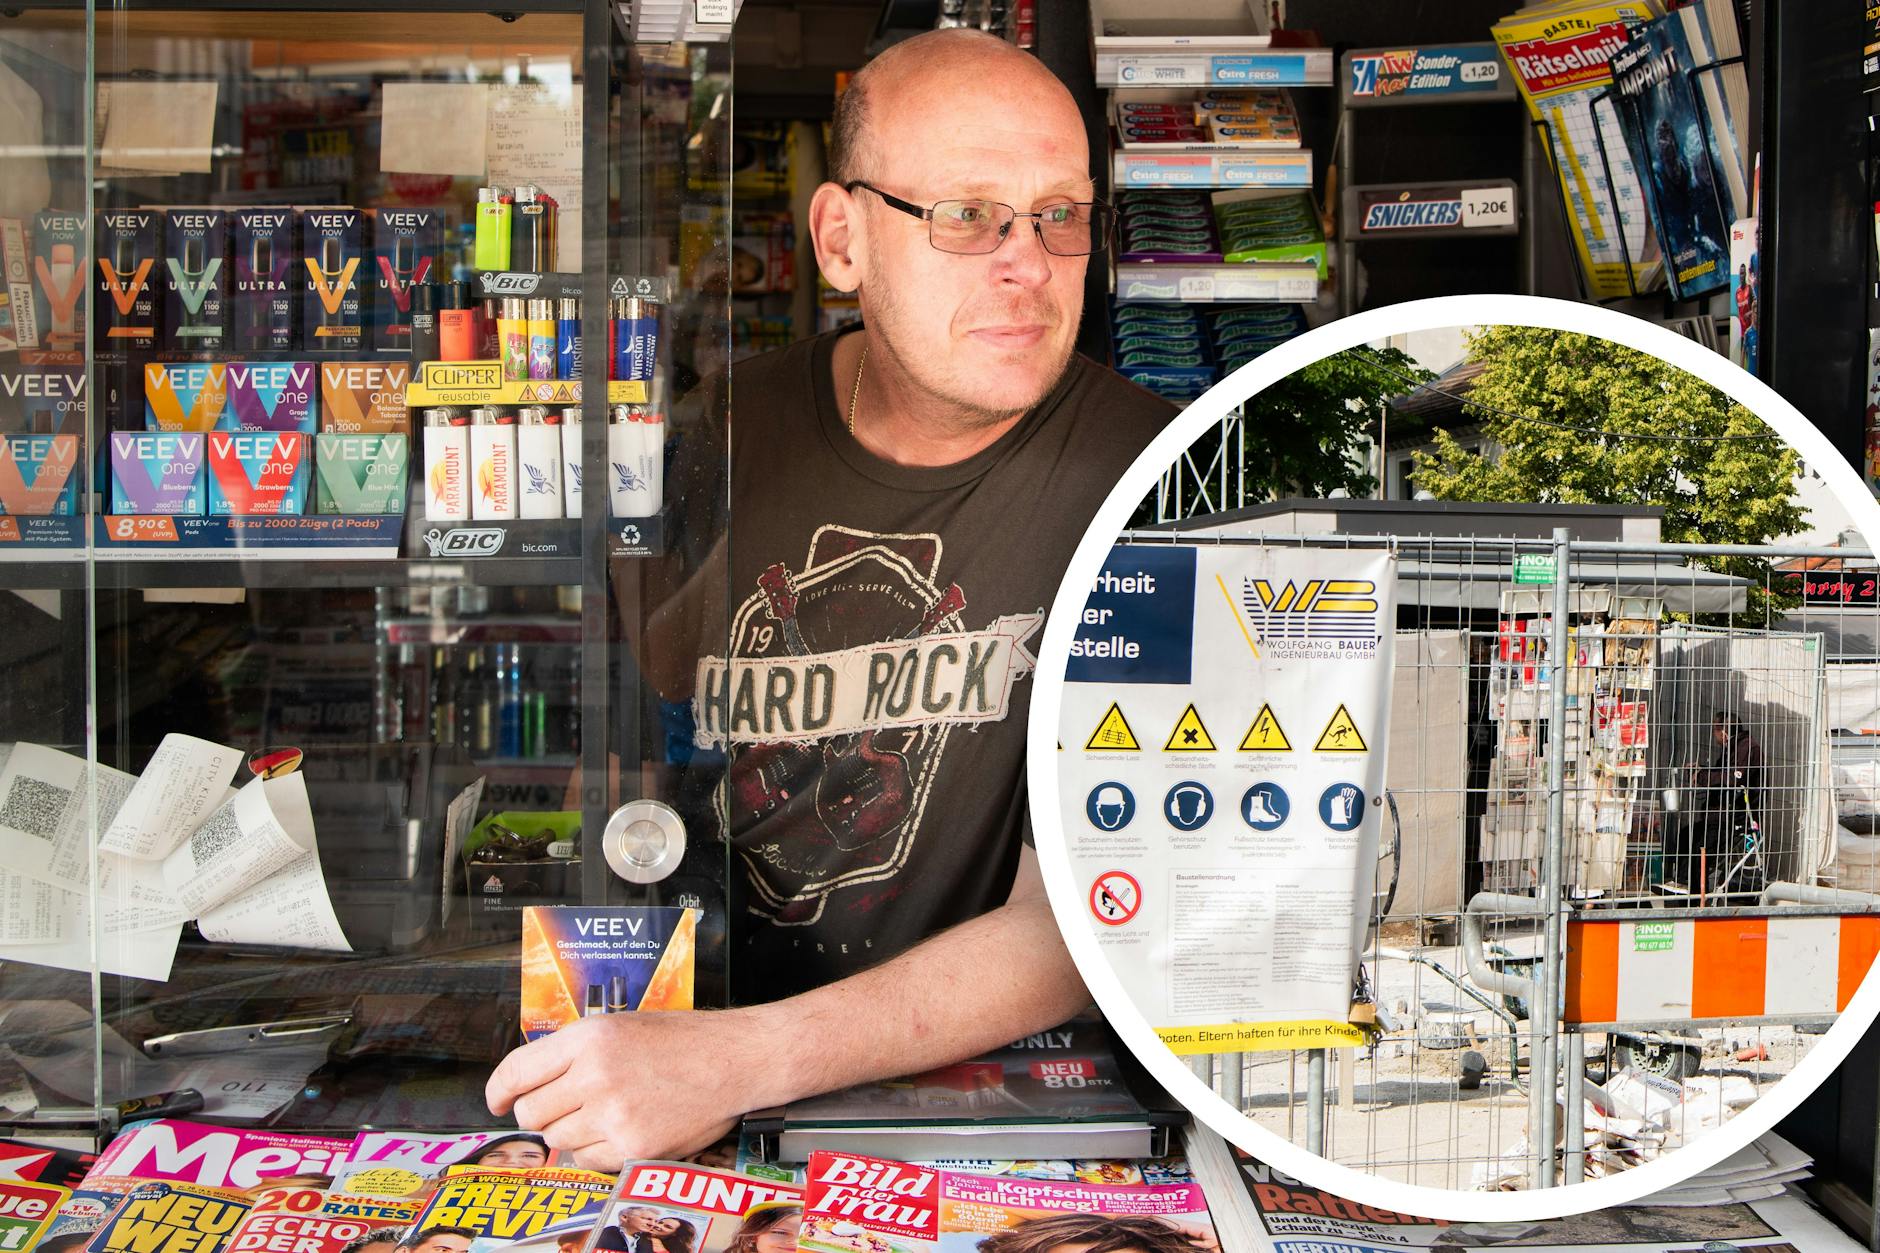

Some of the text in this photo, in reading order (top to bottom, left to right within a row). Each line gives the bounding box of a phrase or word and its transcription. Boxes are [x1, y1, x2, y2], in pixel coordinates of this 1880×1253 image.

[1544, 19, 1591, 38] BASTEI
[1415, 55, 1462, 70] Sonder-
[1155, 71, 1185, 79] WHITE
[1249, 71, 1280, 80] FRESH
[1620, 46, 1677, 96] IMPRINT
[1410, 74, 1451, 89] Edition
[383, 213, 429, 226] VEEV
[1366, 201, 1507, 228] SNICKERS 1,20€
[40, 217, 88, 231] VEEV
[105, 215, 150, 228] VEEV
[172, 215, 218, 228] VEEV
[241, 215, 285, 228] VEEV
[311, 215, 355, 228] VEEV
[52, 231, 76, 240] now
[116, 229, 137, 237] now
[183, 229, 205, 237] now
[394, 227, 417, 235] now
[101, 282, 150, 291] ULTRA
[169, 281, 218, 291] ULTRA
[239, 281, 287, 290] ULTRA
[308, 281, 356, 290] ULTRA
[15, 304, 26, 343] tödlich
[631, 335, 644, 381] Winston
[148, 368, 226, 390] VEEV
[229, 368, 310, 389] VEEV
[325, 368, 405, 390] VEEV
[432, 369, 497, 384] CLIPPER
[1, 374, 86, 397] VEEV
[192, 391, 225, 404] one
[275, 390, 309, 404] one
[370, 391, 402, 404] one
[438, 391, 491, 402] reusable
[57, 400, 87, 412] one
[289, 409, 308, 417] Grape
[337, 423, 361, 431] 2000
[114, 438, 198, 460] VEEV
[212, 438, 296, 460] VEEV
[320, 439, 401, 461] VEEV
[34, 463, 68, 477] one
[161, 462, 196, 475] one
[259, 463, 294, 475] one
[366, 463, 399, 475] one
[445, 445, 460, 514] PARAMOUNT
[493, 443, 507, 512] PARAMOUNT
[163, 484, 196, 492] Blueberry
[228, 519, 246, 528] Bis
[264, 519, 297, 528] 2000
[299, 519, 329, 529] Züge
[332, 519, 343, 529] (2
[522, 543, 558, 553] bic.com
[805, 584, 893, 603] LOVE SERVE
[1860, 580, 1875, 596] 2
[747, 626, 774, 653] 19
[1266, 640, 1376, 650] WOLFGANG BAUER
[1070, 636, 1140, 659] stelle
[1270, 651, 1376, 660] INGENIEURBAU GMBH
[704, 641, 1000, 734] HARD ROCK
[191, 756, 222, 817] CITY KIOSK
[679, 895, 700, 909] Orbit
[575, 918, 644, 936] VEEV
[557, 940, 660, 951] Geschmack, auf den Du
[560, 951, 656, 960] Dich verlassen kannst.
[1199, 1031, 1234, 1041] Eltern
[1237, 1028, 1270, 1039] haften
[1278, 1027, 1297, 1037] für
[1298, 1026, 1321, 1036] ihre
[1041, 1063, 1083, 1075] NEU
[1044, 1075, 1086, 1088] 80
[245, 1133, 288, 1144] Spanien,
[442, 1175, 612, 1192] JEDE WOCHE TOPAKTUELL
[814, 1156, 935, 1198] Bild
[952, 1175, 980, 1186] Nach
[953, 1181, 993, 1191] Jahren:
[996, 1182, 1190, 1201] Kopfschmerzen?
[860, 1188, 899, 1202] der
[945, 1186, 1100, 1212] Endlich weg!
[253, 1190, 324, 1214] 20
[329, 1194, 390, 1206] Seiten
[808, 1185, 932, 1229] Frau
[57, 1208, 102, 1217] Werbung
[986, 1212, 1009, 1220] den
[247, 1217, 361, 1241] ECHO
[1269, 1216, 1376, 1232] Und der Bezirk
[917, 1232, 936, 1240] gut
[1274, 1224, 1324, 1234] schaut
[1360, 1230, 1395, 1242] Seite
[1399, 1235, 1410, 1243] 4
[237, 1234, 324, 1253] DER
[1280, 1243, 1363, 1253] HERTHA
